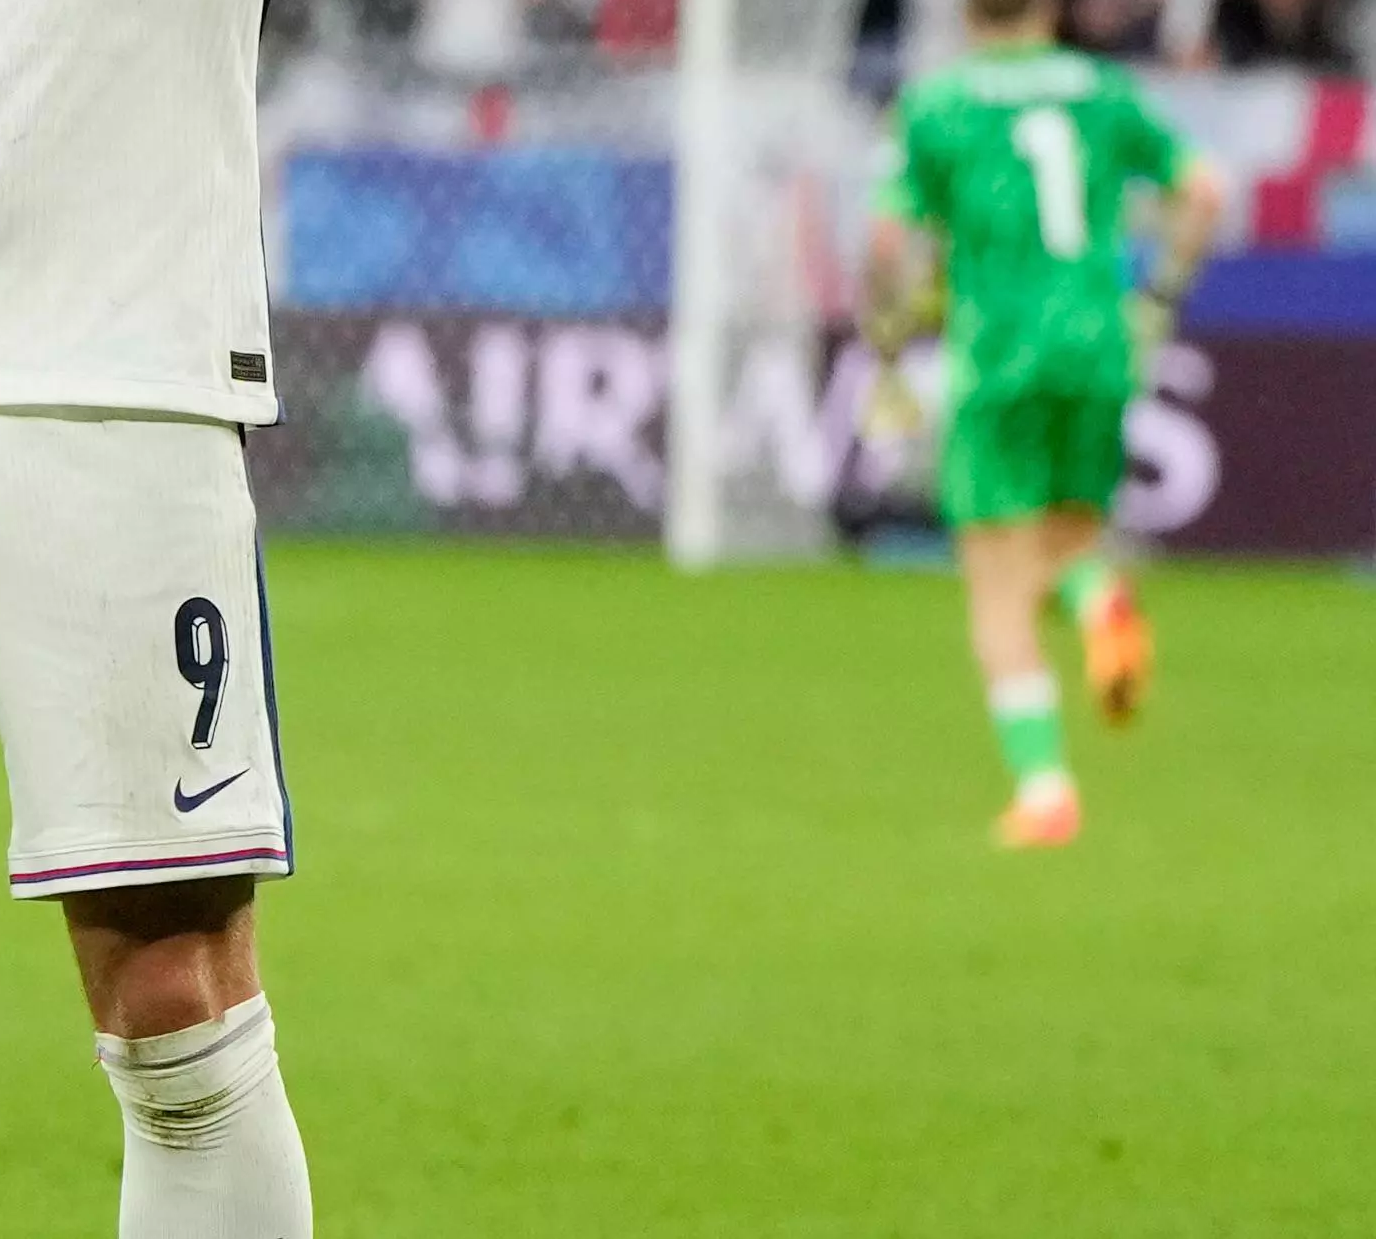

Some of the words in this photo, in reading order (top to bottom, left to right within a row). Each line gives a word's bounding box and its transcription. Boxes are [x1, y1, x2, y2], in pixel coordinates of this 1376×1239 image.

[1011, 106, 1090, 262] 1
[367, 318, 1222, 535] IRWS
[174, 596, 230, 750] 9
